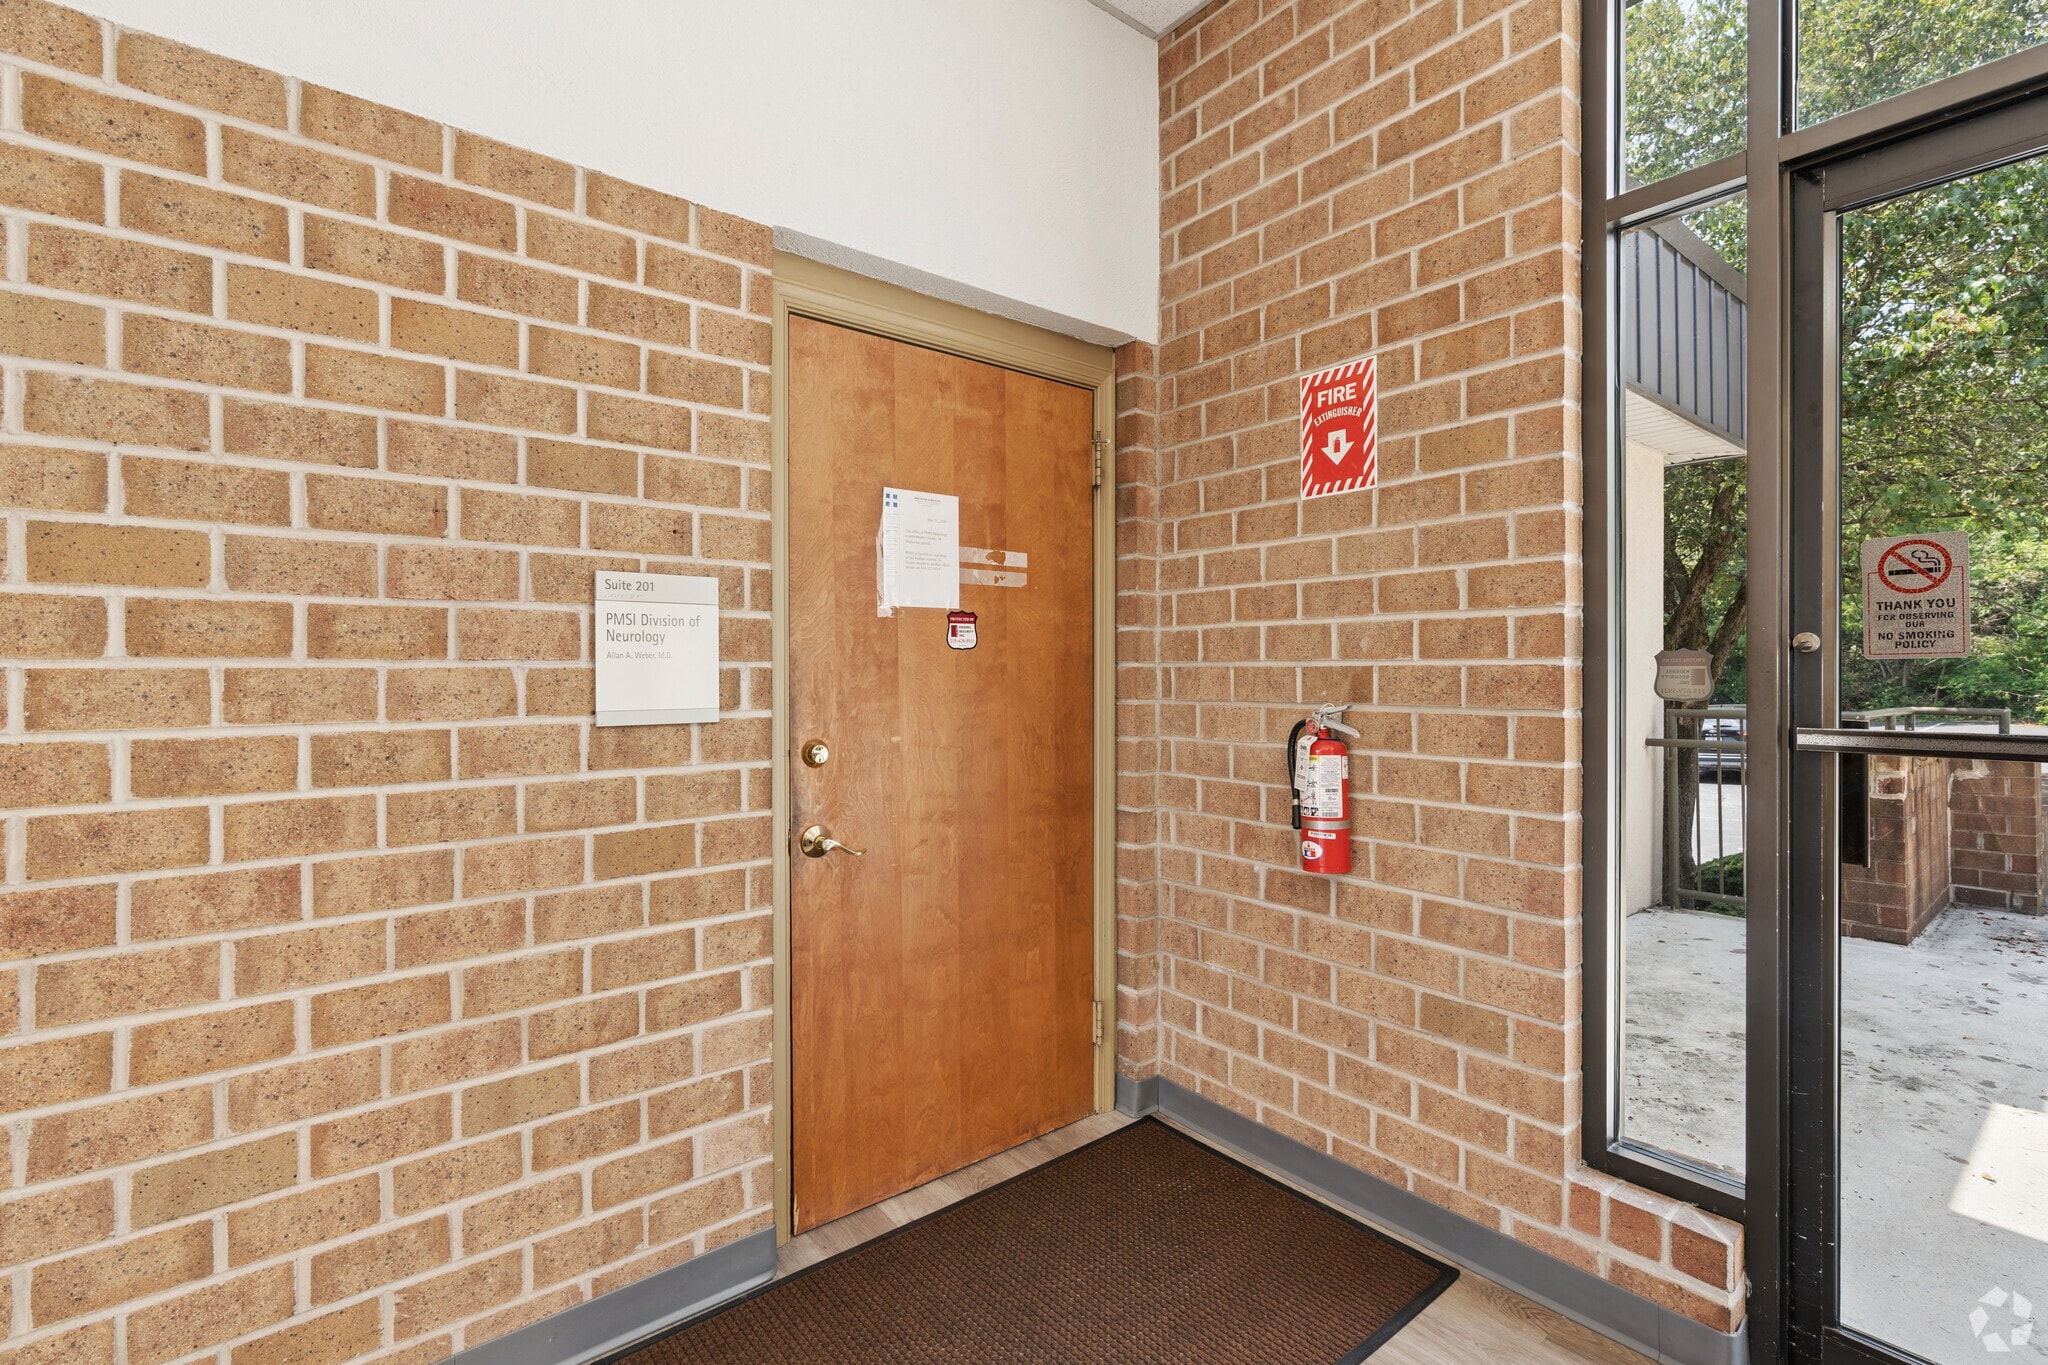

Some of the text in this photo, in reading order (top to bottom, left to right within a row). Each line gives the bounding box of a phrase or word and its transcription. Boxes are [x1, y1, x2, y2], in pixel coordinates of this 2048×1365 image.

[1317, 382, 1357, 408] FIRE
[1313, 406, 1363, 427] EXTINGUISHER
[605, 579, 654, 592] Suite 201
[1876, 598, 1956, 611] THANK YOU
[606, 612, 701, 628] PMSI Division of
[1899, 611, 1954, 620] OBSERVING
[606, 629, 666, 645] Neurology
[1878, 630, 1955, 640] NO SMOKING
[1895, 640, 1936, 649] POLICY
[606, 651, 624, 659] Allan
